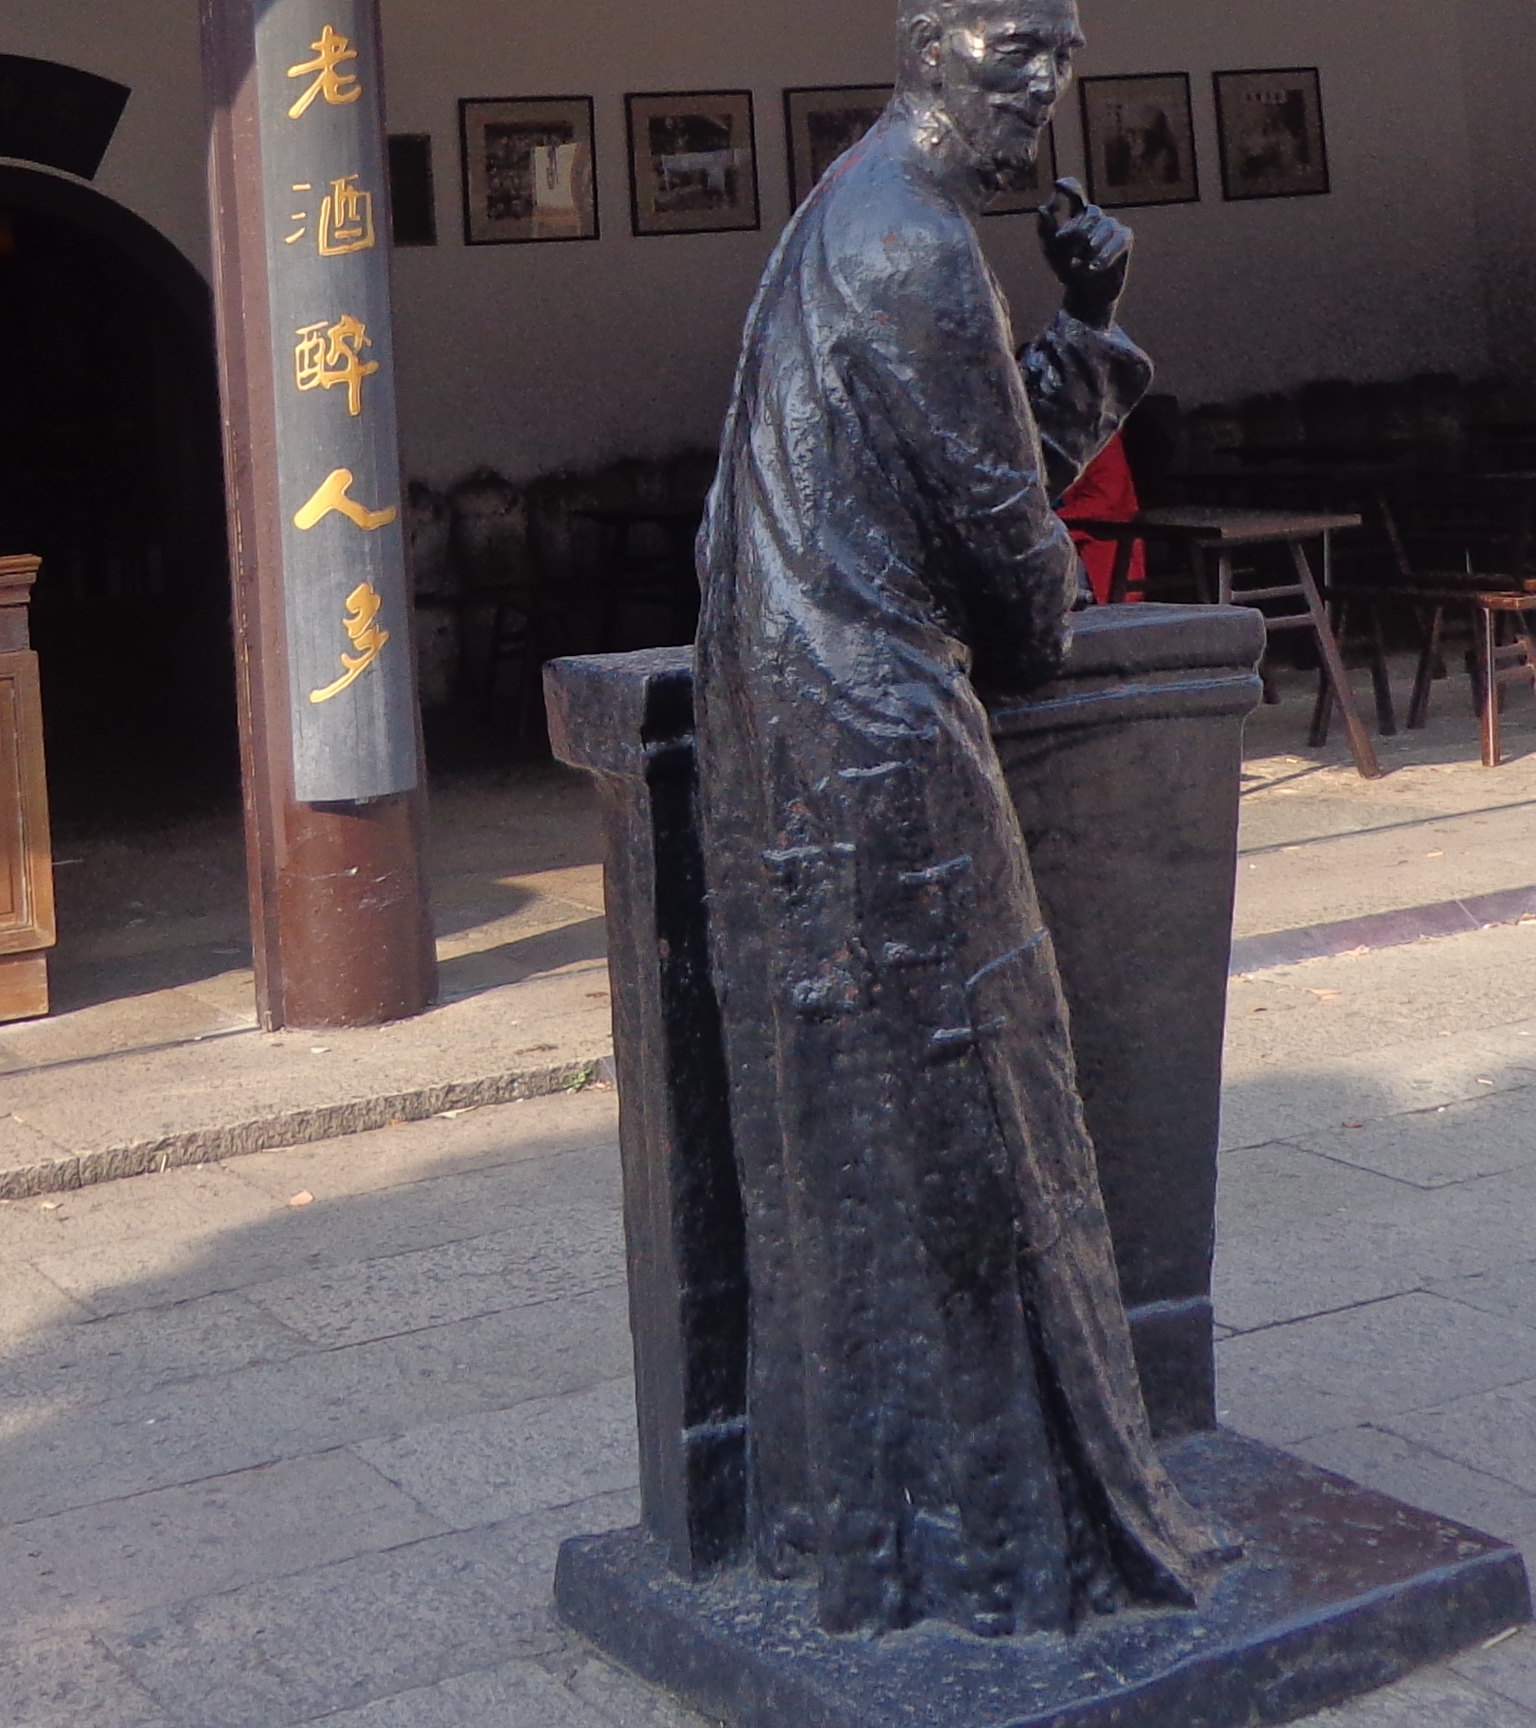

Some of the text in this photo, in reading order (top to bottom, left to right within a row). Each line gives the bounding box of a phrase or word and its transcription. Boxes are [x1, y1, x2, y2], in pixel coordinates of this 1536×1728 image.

[286, 24, 396, 704] 老酒醉人多
